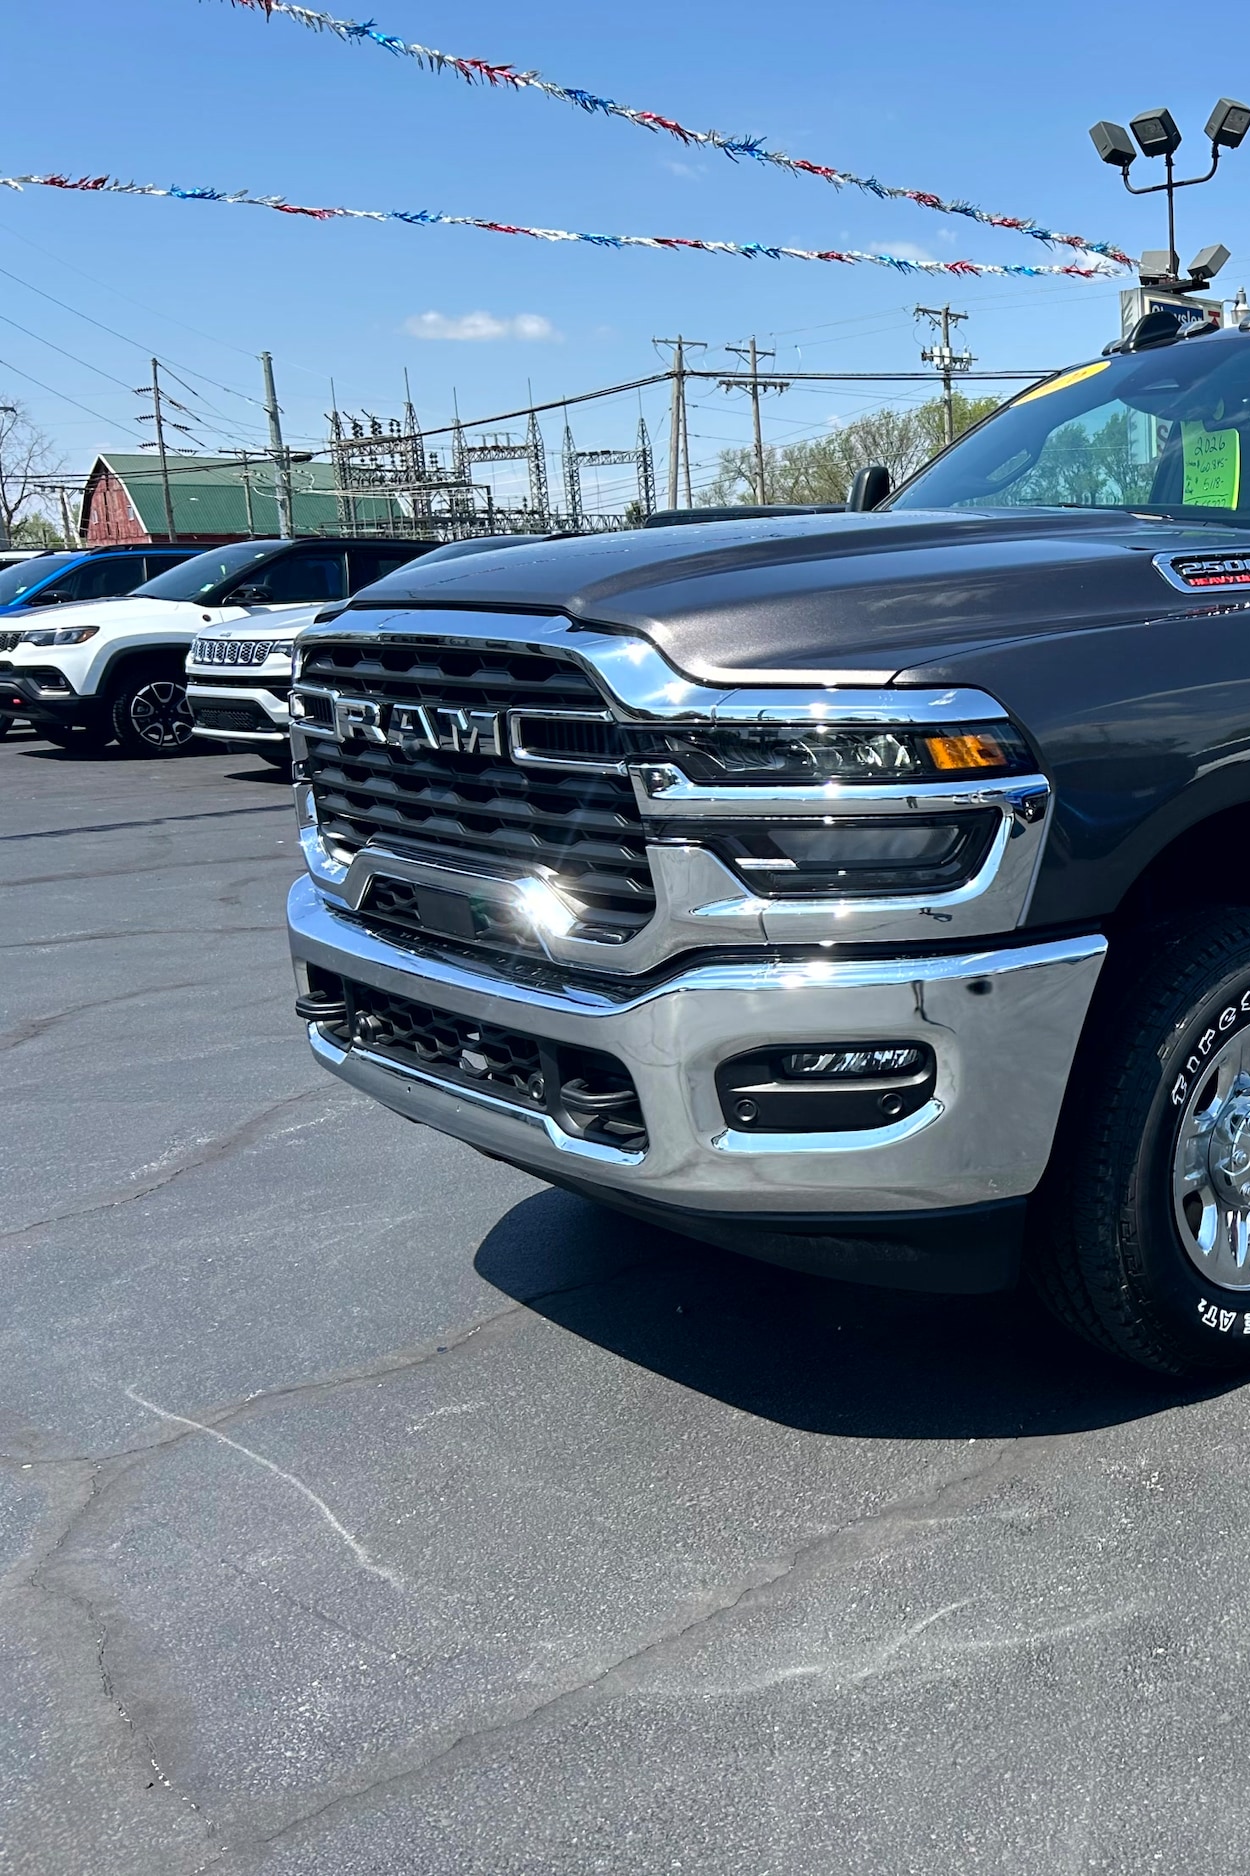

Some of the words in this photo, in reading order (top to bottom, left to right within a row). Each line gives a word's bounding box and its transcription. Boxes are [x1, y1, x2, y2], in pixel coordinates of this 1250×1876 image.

[1194, 436, 1226, 456] 2026
[1188, 575, 1235, 586] HEAVY
[335, 699, 501, 756] RAM
